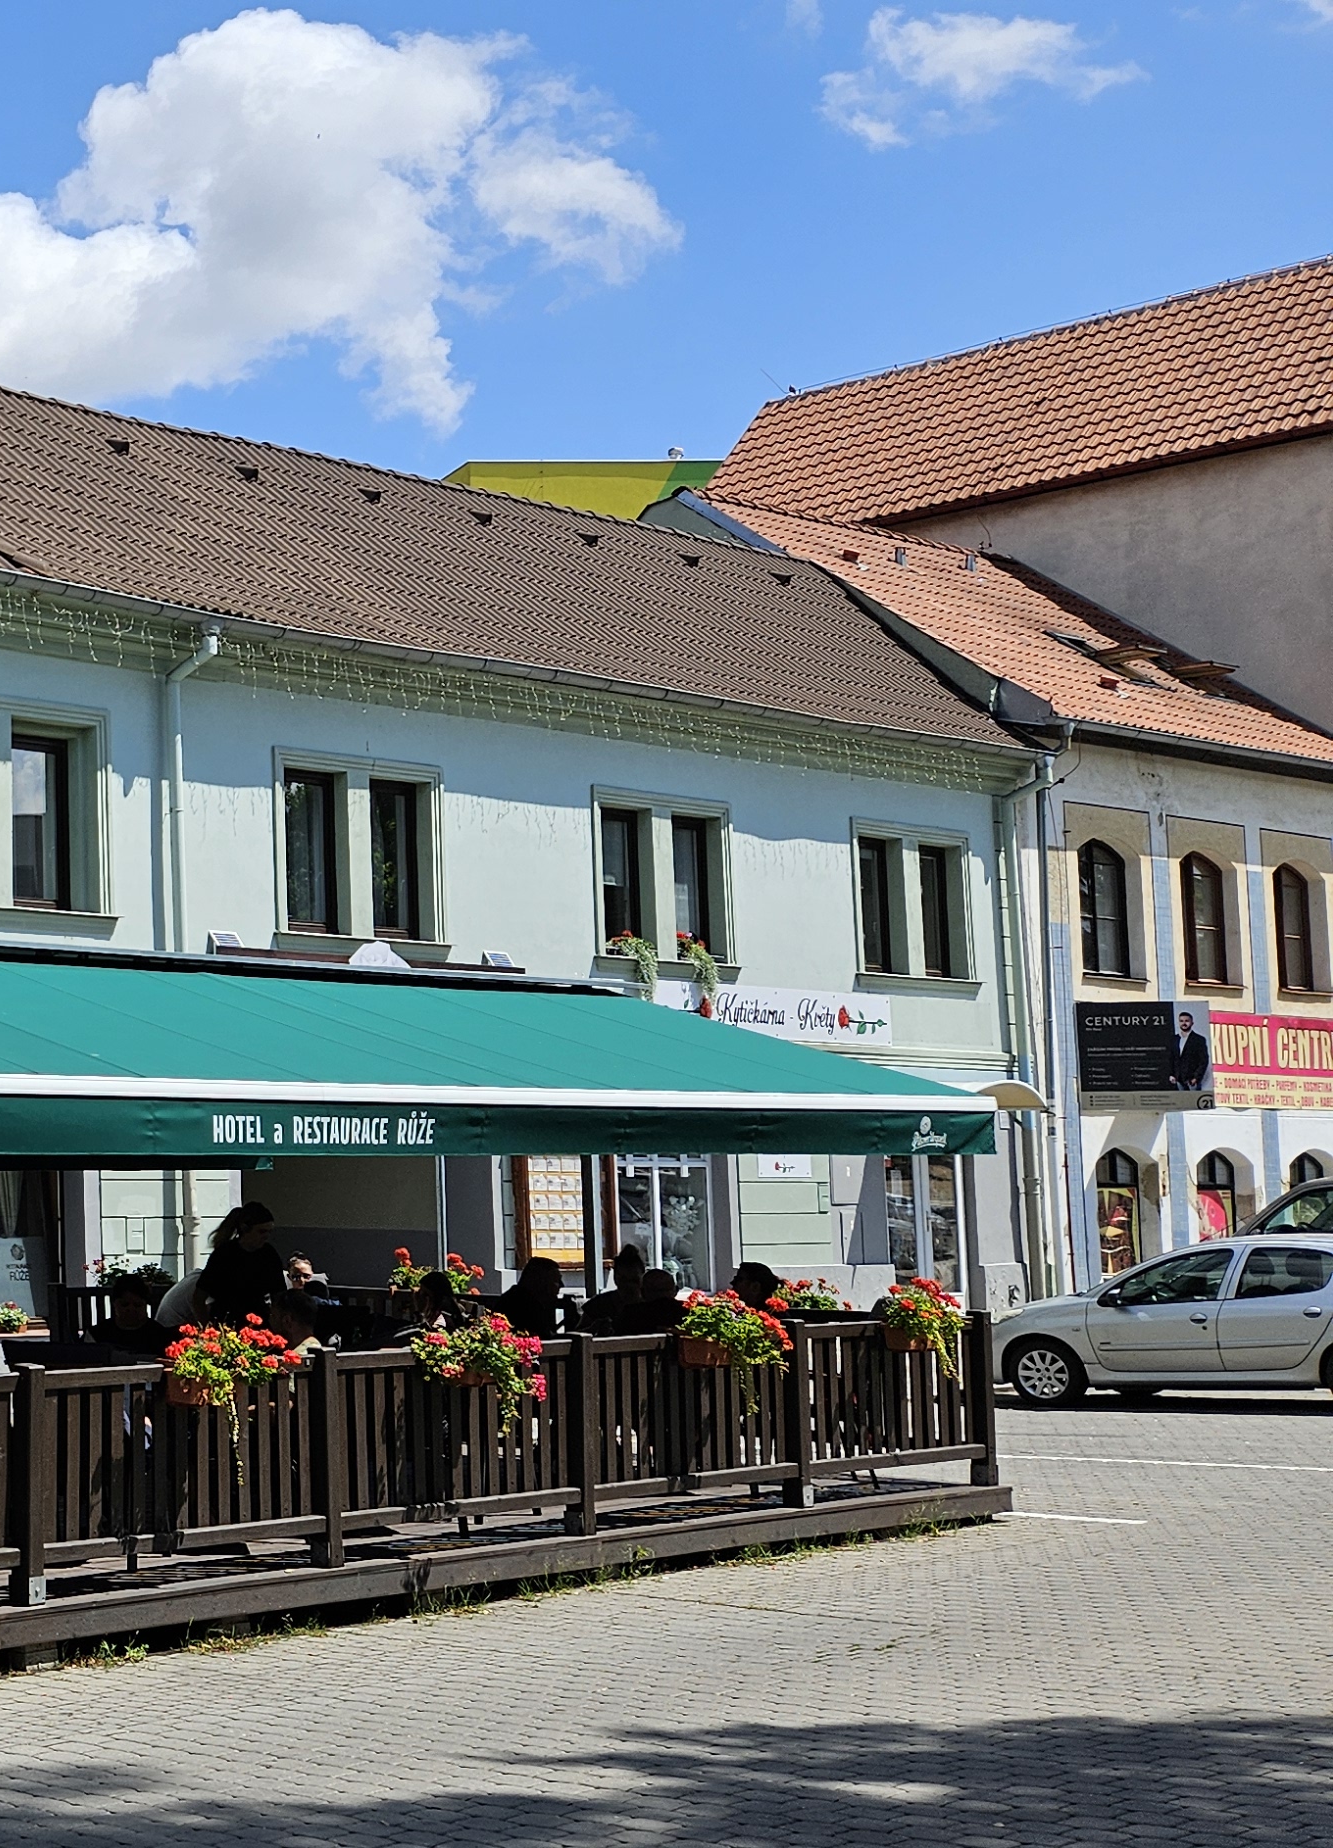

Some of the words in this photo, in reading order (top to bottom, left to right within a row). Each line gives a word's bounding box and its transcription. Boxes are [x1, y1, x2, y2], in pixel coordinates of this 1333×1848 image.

[716, 992, 785, 1026] Kytičkárna
[797, 998, 836, 1035] Květy
[1085, 1016, 1149, 1026] CENTURY
[1153, 1015, 1165, 1025] 21
[1277, 1027, 1333, 1070] CENTR
[1202, 1099, 1213, 1109] 21
[213, 1115, 265, 1144] HOTEL
[274, 1123, 283, 1144] a
[293, 1115, 389, 1145] RESTAURACE
[397, 1111, 436, 1145] RŮŽE
